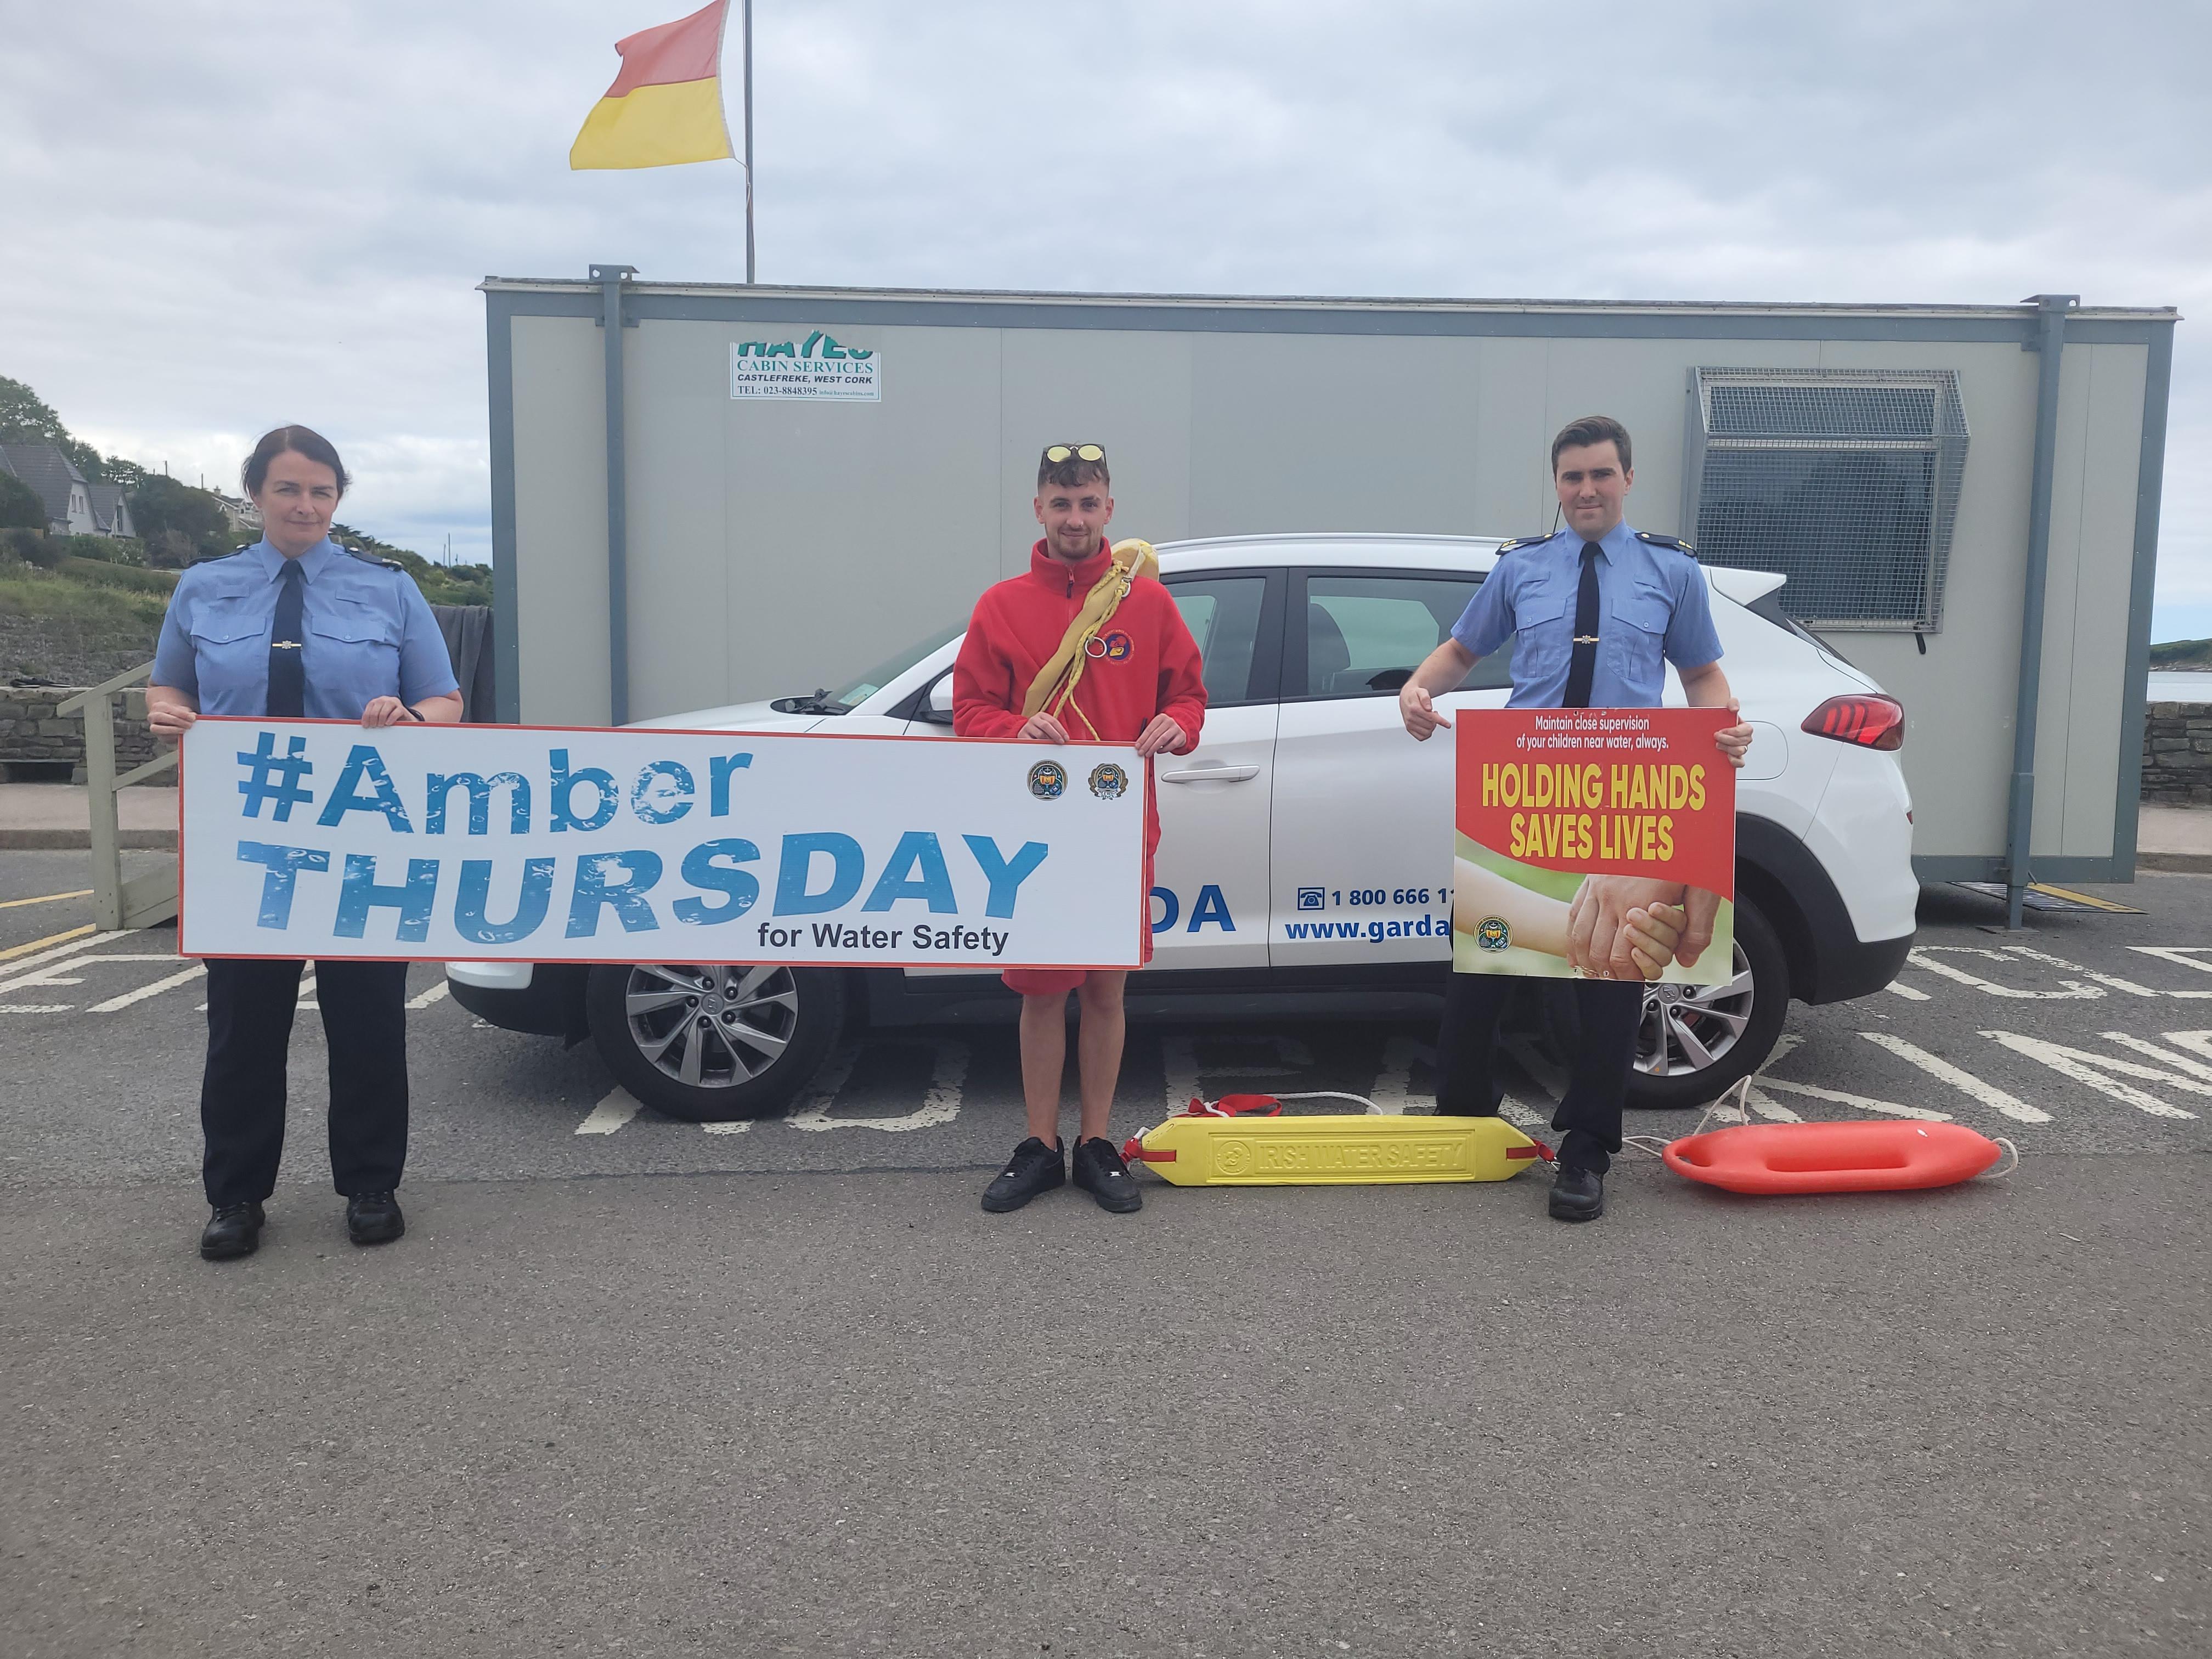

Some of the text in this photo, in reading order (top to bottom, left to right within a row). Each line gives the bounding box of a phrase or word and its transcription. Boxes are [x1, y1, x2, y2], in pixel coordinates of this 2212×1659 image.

[737, 359, 873, 374] CABIN SERVICES
[737, 374, 811, 384] CASTLEFREKE,
[814, 375, 842, 383] WEST
[738, 386, 761, 394] TEL:
[763, 386, 817, 396] 023-8848395
[1536, 715, 1649, 733] Maintain close supervision
[1516, 733, 1669, 752] of your children near water, always.
[236, 731, 754, 836] #Amber
[1483, 763, 1706, 810] HOLDING HANDS
[1510, 812, 1674, 861] SAVES LIVES
[237, 831, 1049, 945] THURSDAY
[1331, 891, 1341, 906] 1
[1349, 889, 1386, 906] 800
[1393, 888, 1430, 905] 666
[758, 922, 1009, 956] for Water Safety
[1285, 915, 1450, 943] www.garda
[1260, 1145, 1310, 1169] IRISH
[1317, 1144, 1383, 1169] WATER
[1386, 1143, 1464, 1168] SAFETY
